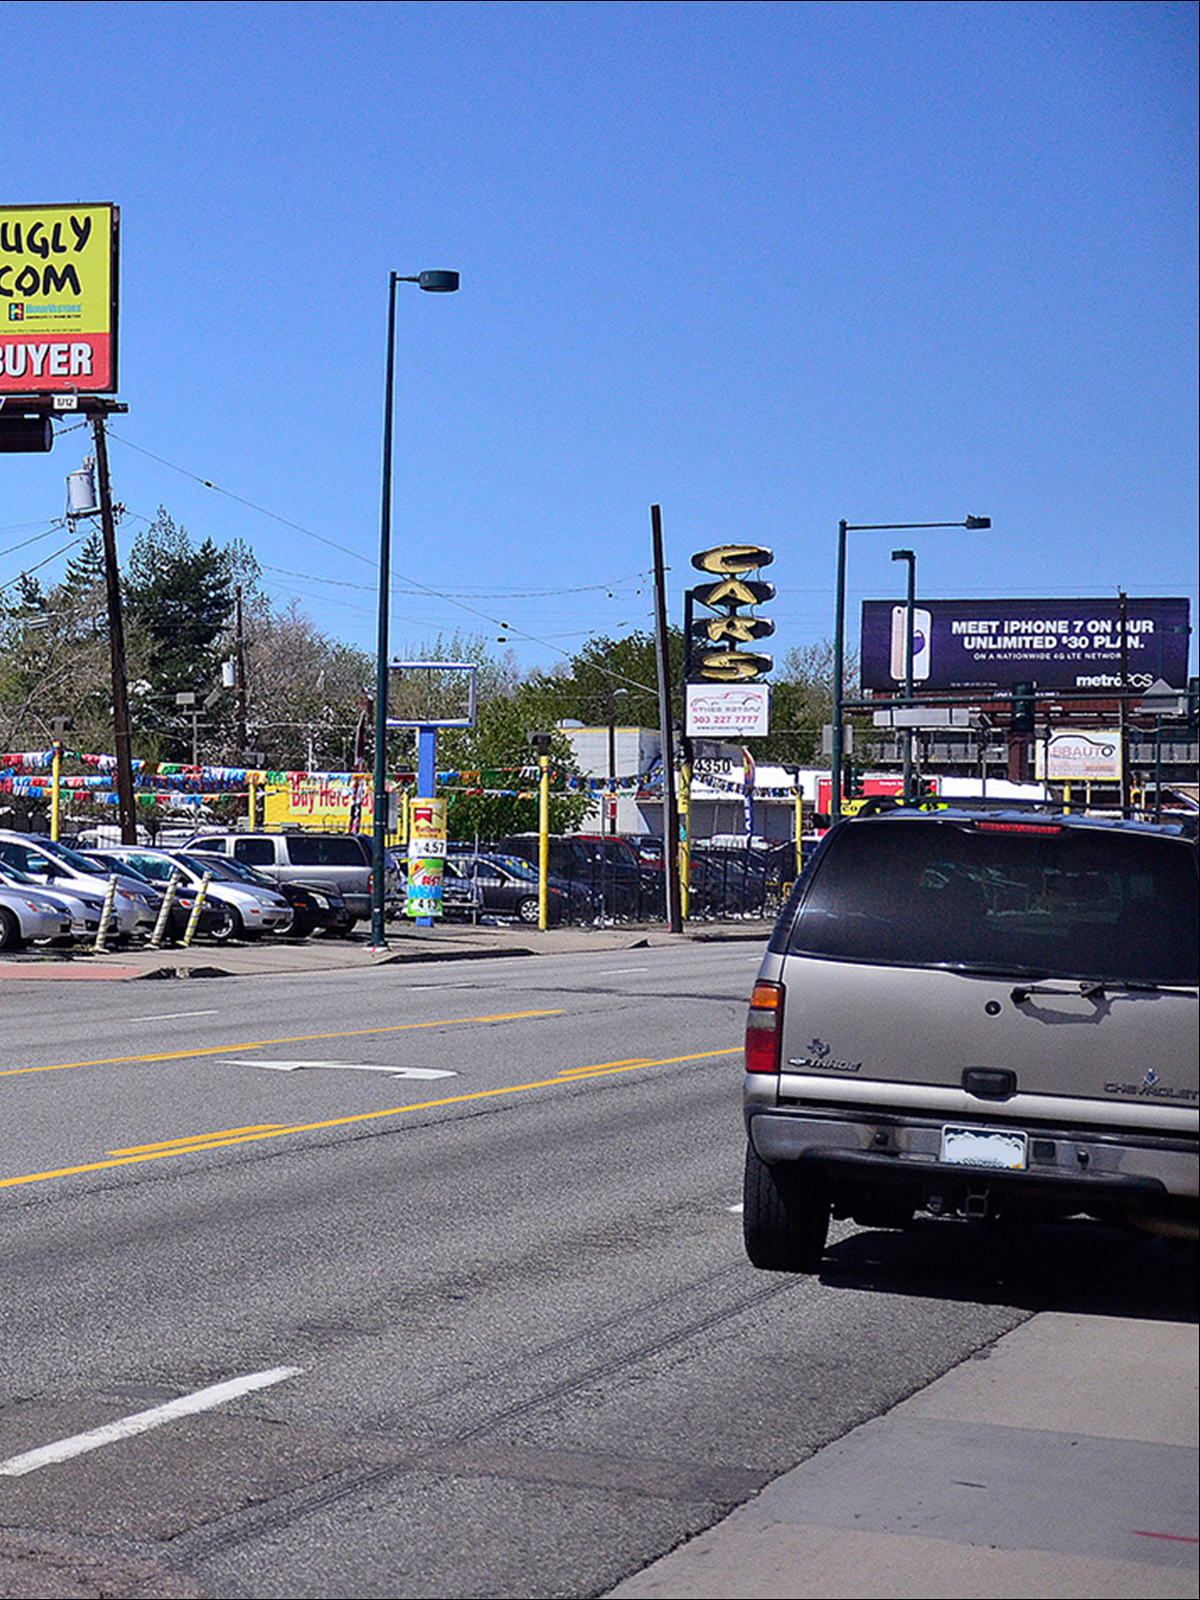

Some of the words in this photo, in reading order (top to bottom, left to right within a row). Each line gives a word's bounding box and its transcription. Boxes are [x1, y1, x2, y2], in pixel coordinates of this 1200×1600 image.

[0, 215, 92, 259] UGLY
[951, 621, 1000, 634] MEET
[1073, 620, 1084, 633] 7
[1087, 620, 1112, 633] ON
[1116, 620, 1154, 633] OUR
[963, 636, 1057, 649] UNLIMITED
[1061, 636, 1089, 649] $30
[692, 715, 711, 724] 303
[713, 715, 732, 724] 227
[735, 715, 759, 724] 7777
[694, 759, 731, 774] 4350
[423, 841, 445, 854] 4.57
[1104, 1082, 1198, 1100] CHEVROLET
